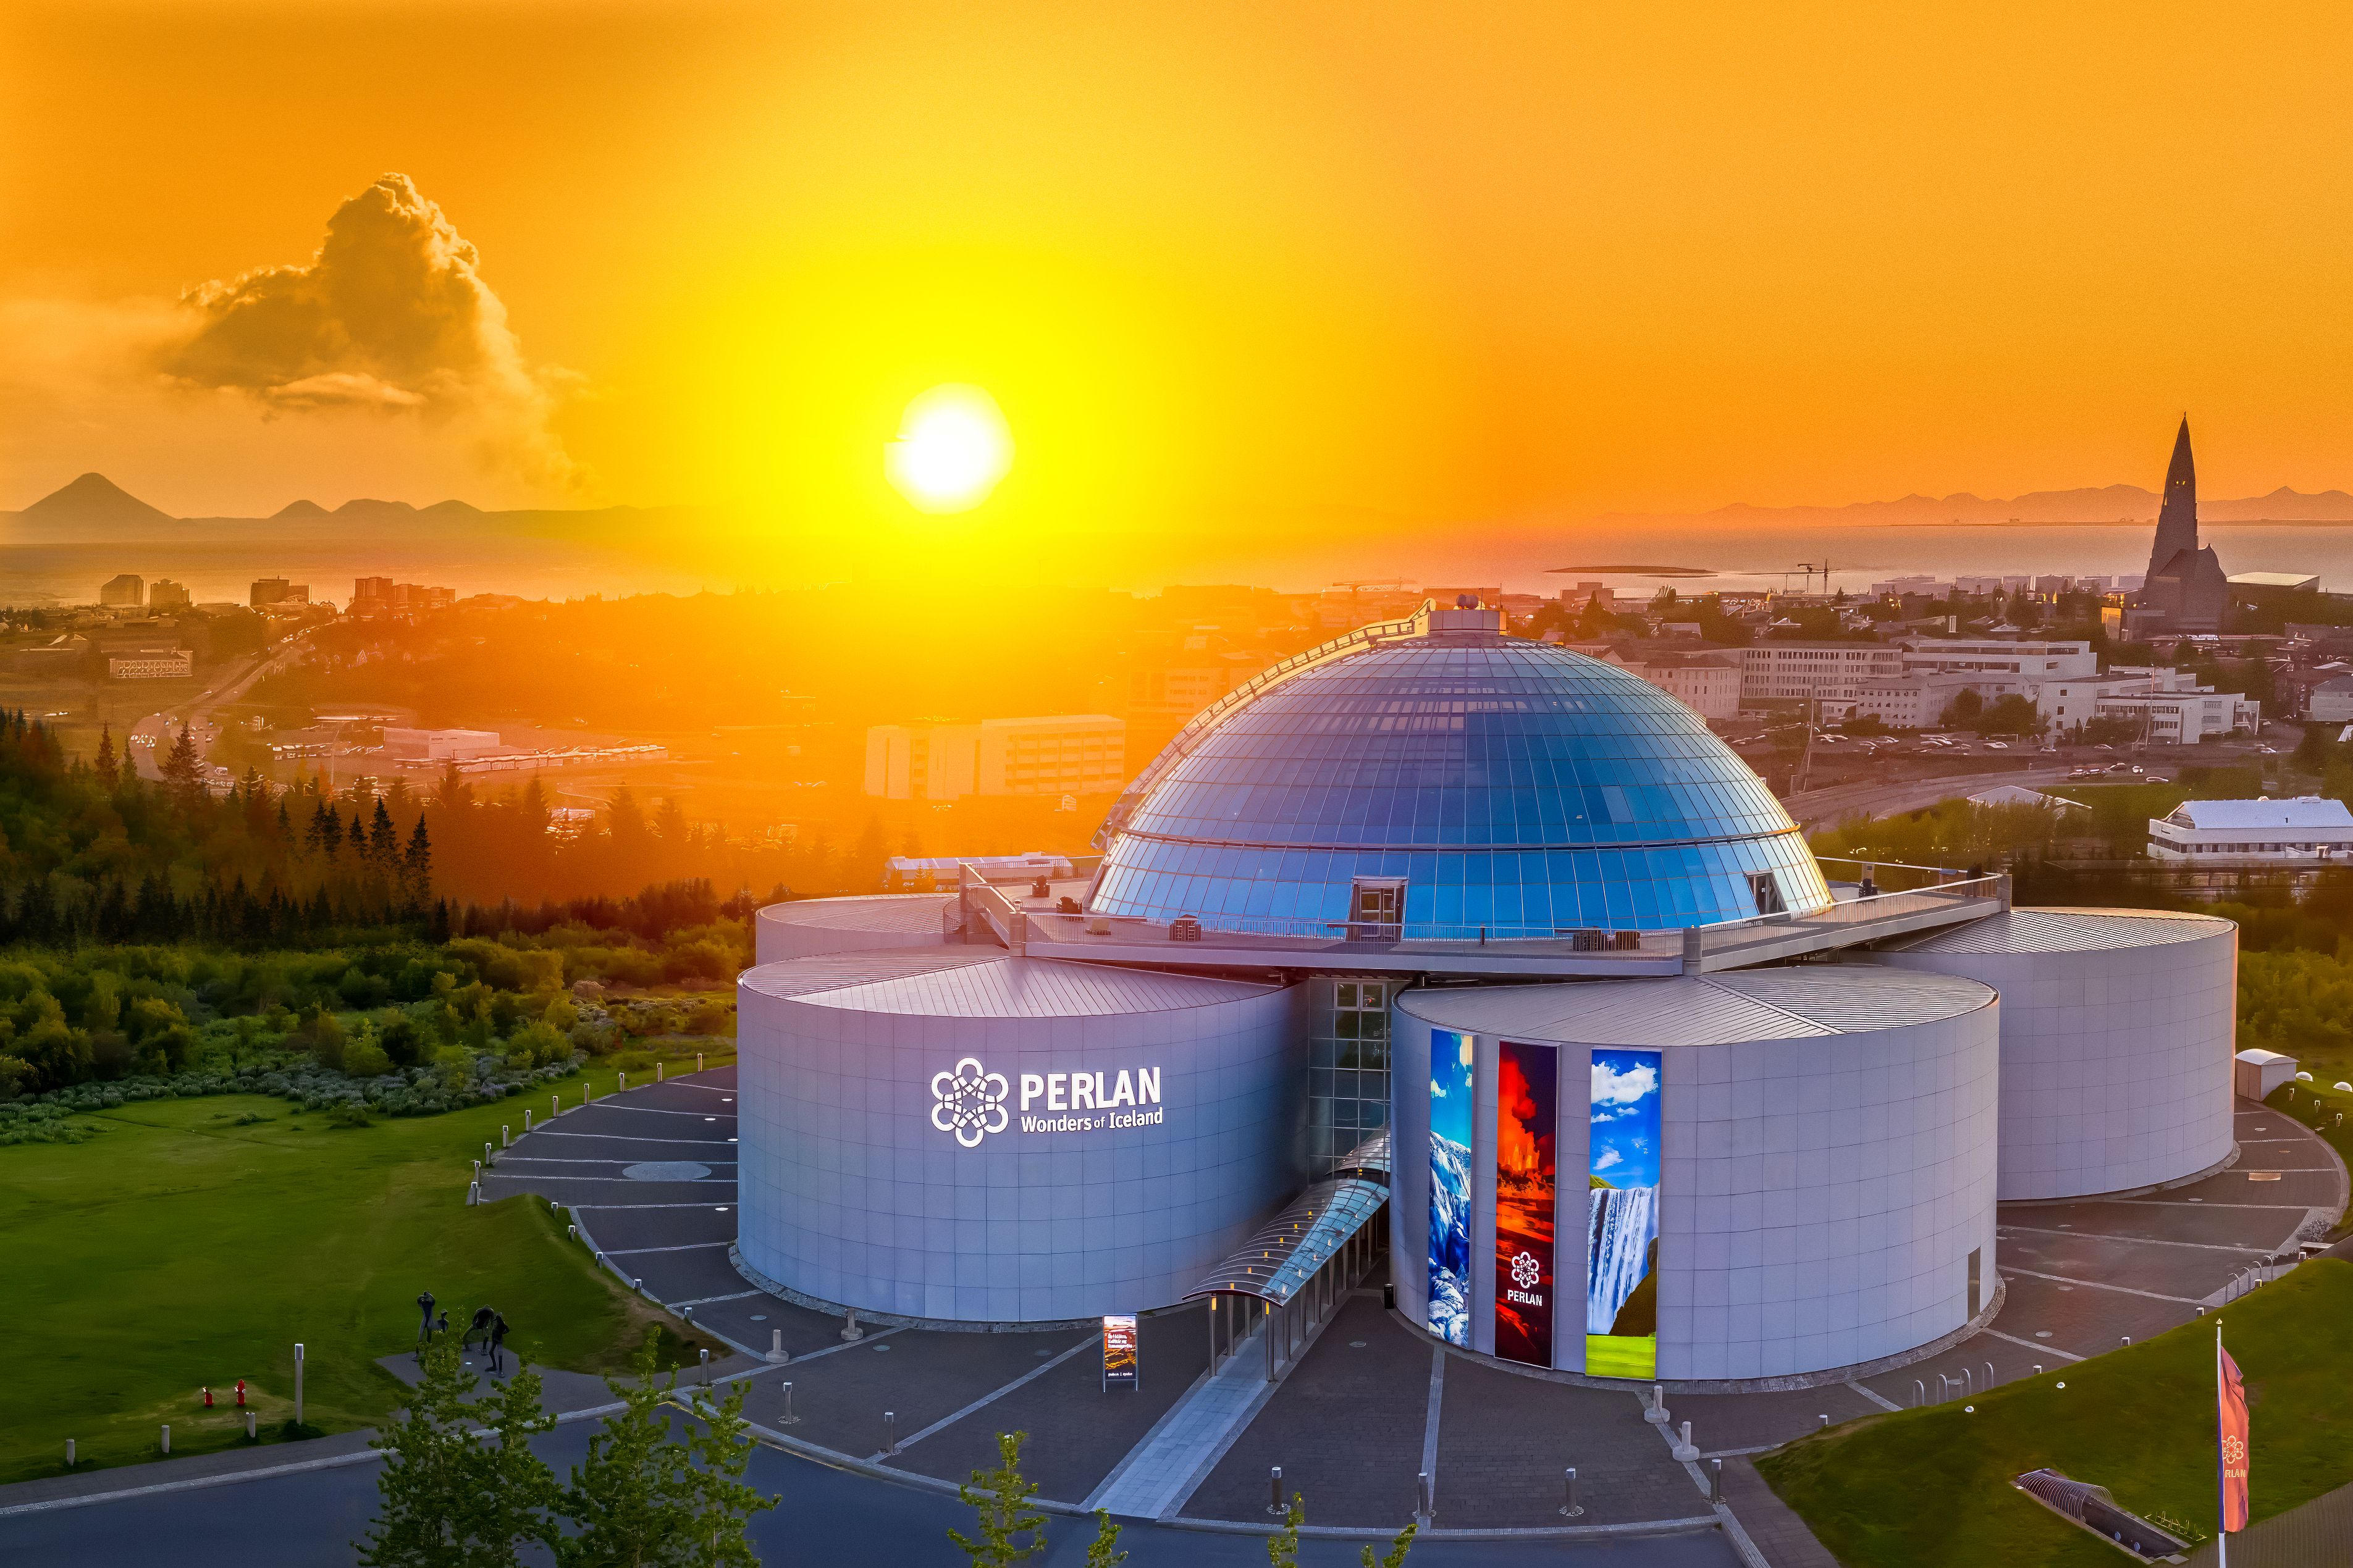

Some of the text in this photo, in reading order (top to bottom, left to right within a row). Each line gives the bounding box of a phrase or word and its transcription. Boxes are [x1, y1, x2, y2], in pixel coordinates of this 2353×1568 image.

[1021, 1067, 1161, 1111] PERLAN
[1021, 1107, 1163, 1133] Wonders of Iceland
[1507, 1289, 1543, 1306] PERLAN
[2225, 1469, 2246, 1478] RLAN
